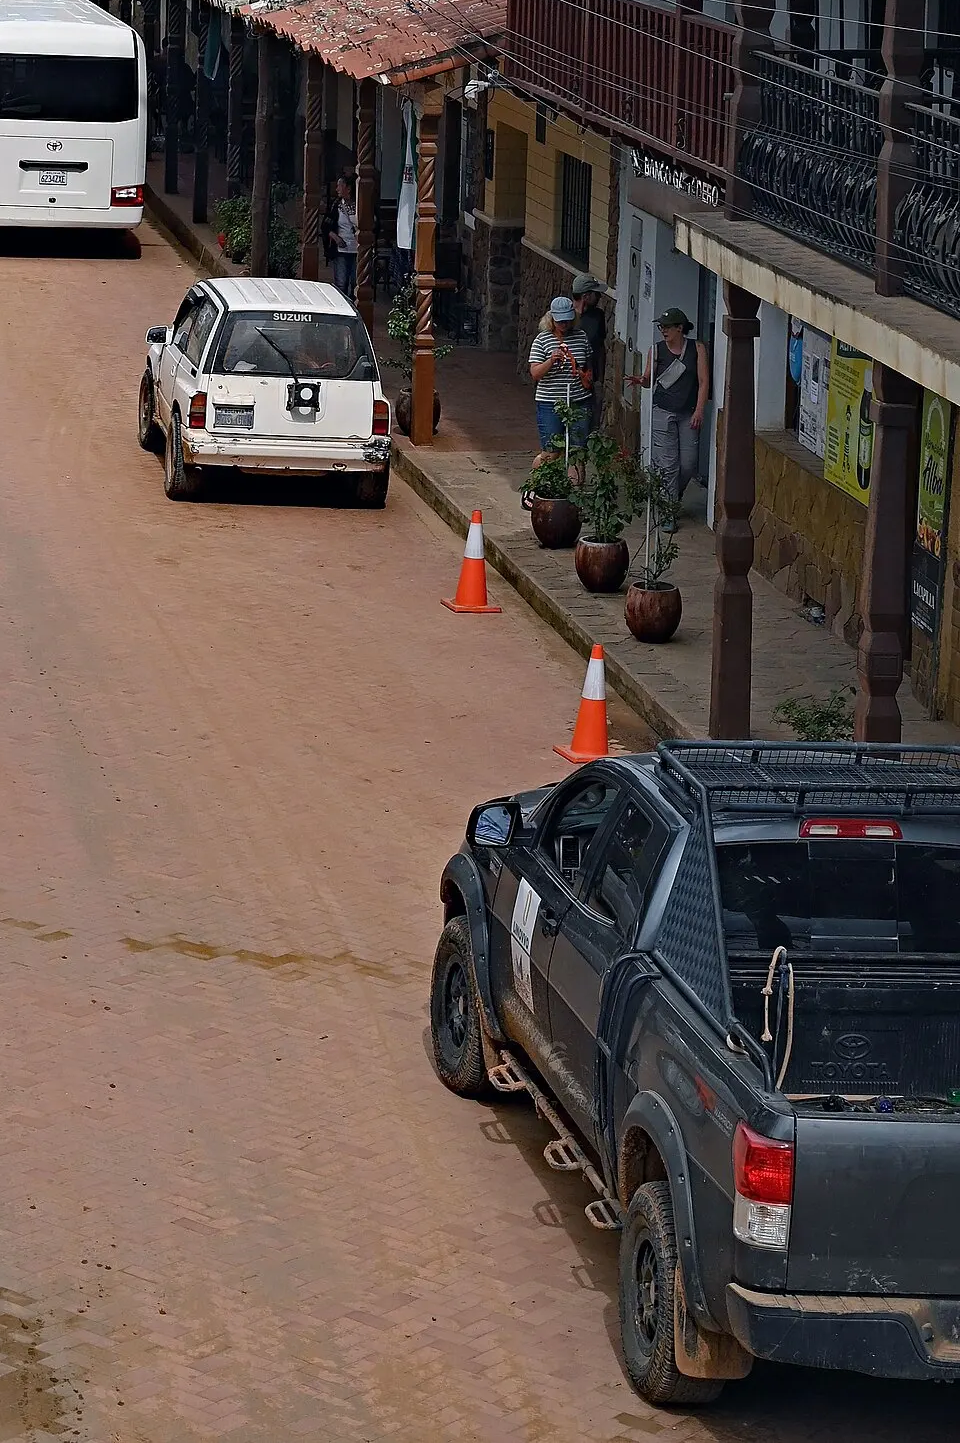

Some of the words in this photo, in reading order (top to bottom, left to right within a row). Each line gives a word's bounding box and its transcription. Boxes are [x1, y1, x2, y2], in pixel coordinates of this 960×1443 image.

[673, 169, 719, 207] GAADERO
[273, 312, 312, 322] SUZUKI
[811, 1061, 890, 1079] TOYOTA
